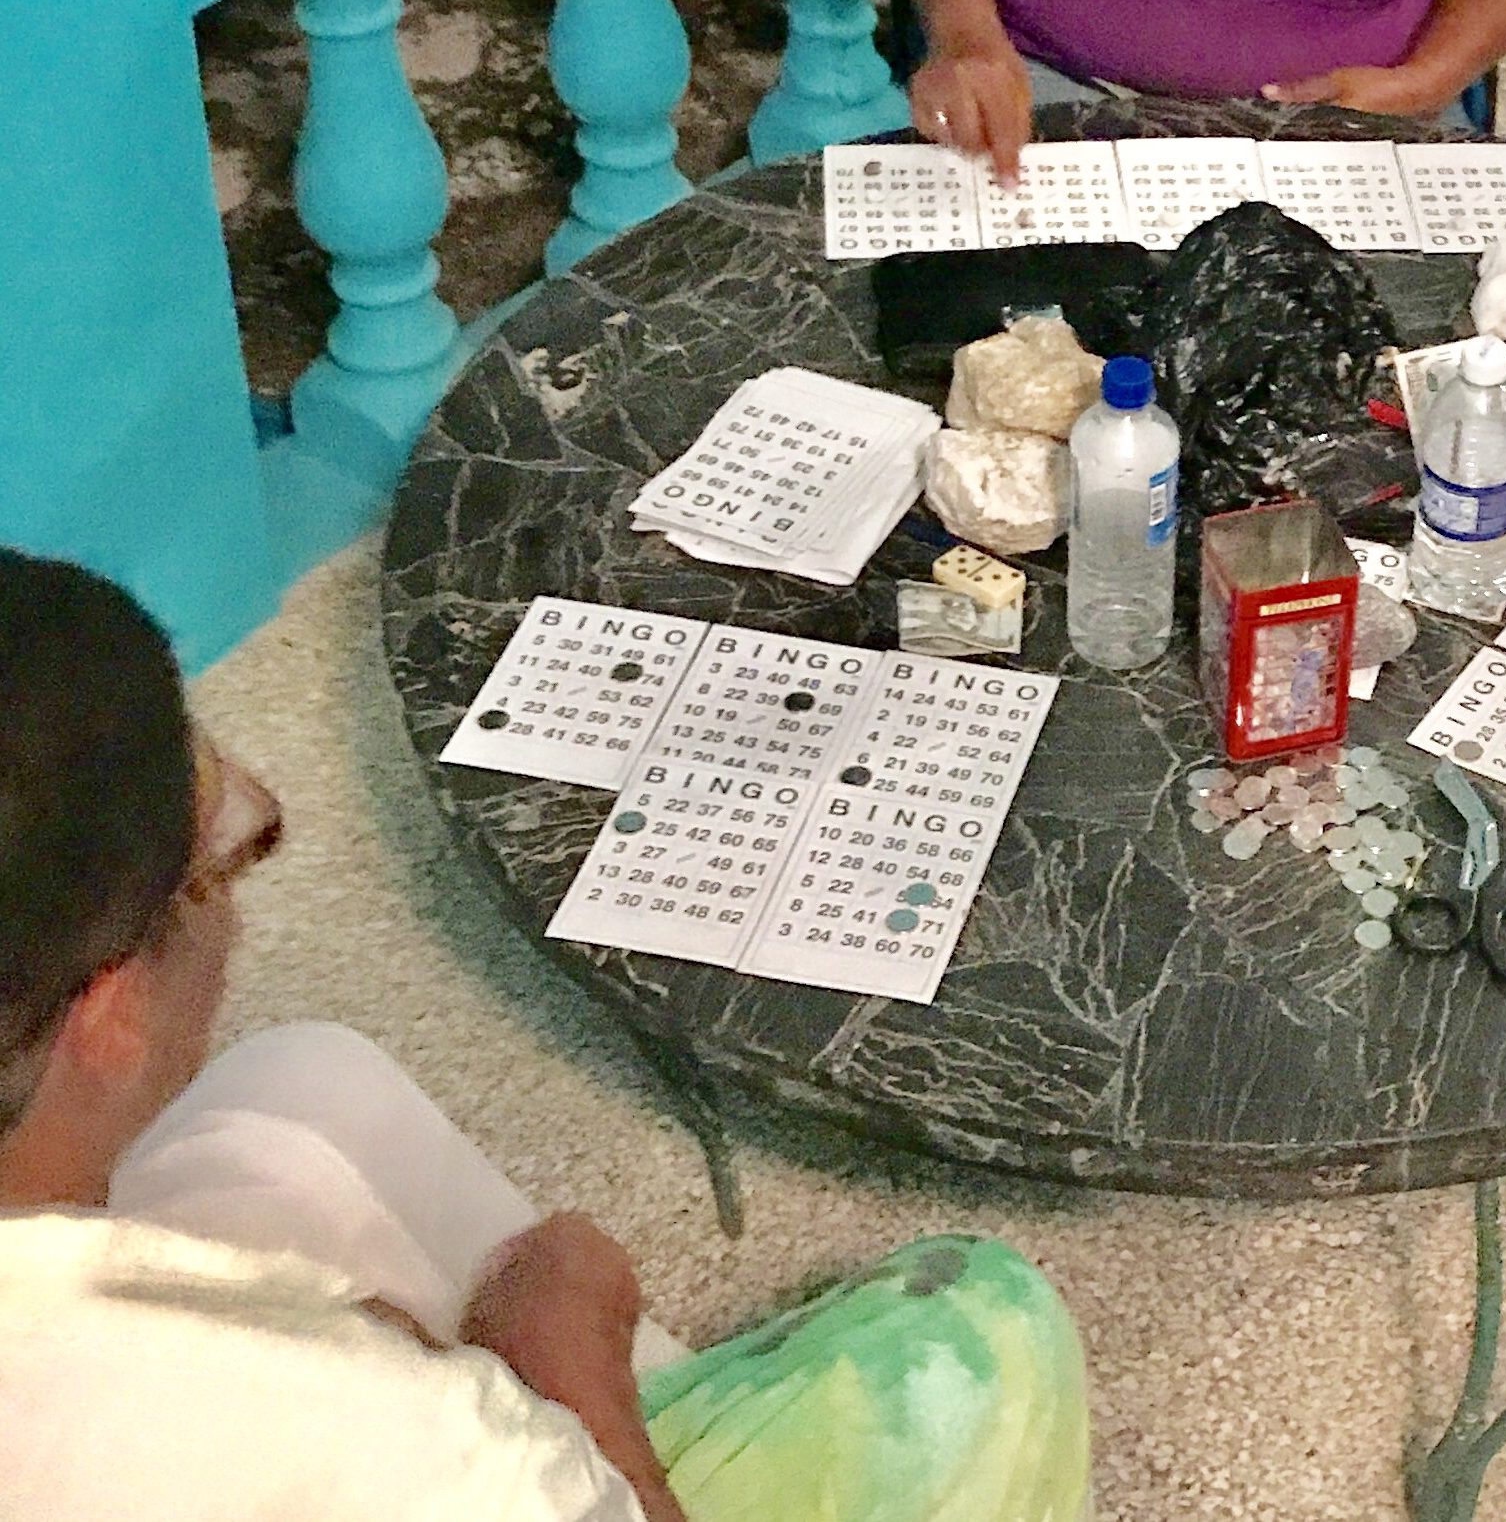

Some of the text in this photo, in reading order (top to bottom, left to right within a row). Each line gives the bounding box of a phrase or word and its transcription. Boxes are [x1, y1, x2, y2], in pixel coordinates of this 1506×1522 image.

[839, 238, 966, 250] BINGO
[663, 485, 794, 532] BINGO
[542, 610, 687, 645] BINGO
[716, 638, 862, 673] BINGO
[708, 663, 858, 696] 3 23 40 48 63
[893, 664, 1038, 700] BINGO
[722, 688, 748, 701] 22
[754, 693, 780, 706] 39
[818, 704, 842, 716] 69
[884, 688, 1029, 721] 14 24 43 53 61
[876, 709, 1021, 742] 2 19 31 56 62
[866, 731, 1011, 763] 4 22 52 64
[645, 766, 799, 804] BINGO
[857, 752, 1003, 785] 6 21 39 49 70
[871, 779, 994, 808] 25 44 59 69
[636, 794, 788, 828] 5 22 37 56 75
[829, 799, 983, 837] BINGO
[651, 822, 778, 852] 25 42 60 65
[819, 826, 973, 862] 10 20 36 58 66
[612, 842, 766, 875] 3 27 49 61
[809, 851, 964, 886] 12 28 40 54 68
[597, 864, 757, 898] 13 28 40 59 67
[800, 874, 815, 887] 5
[827, 880, 853, 894] 22
[586, 888, 744, 924] 2 30 38 48 62
[789, 899, 944, 934] 8 25 41 71
[777, 923, 935, 958] 3 24 38 60 70
